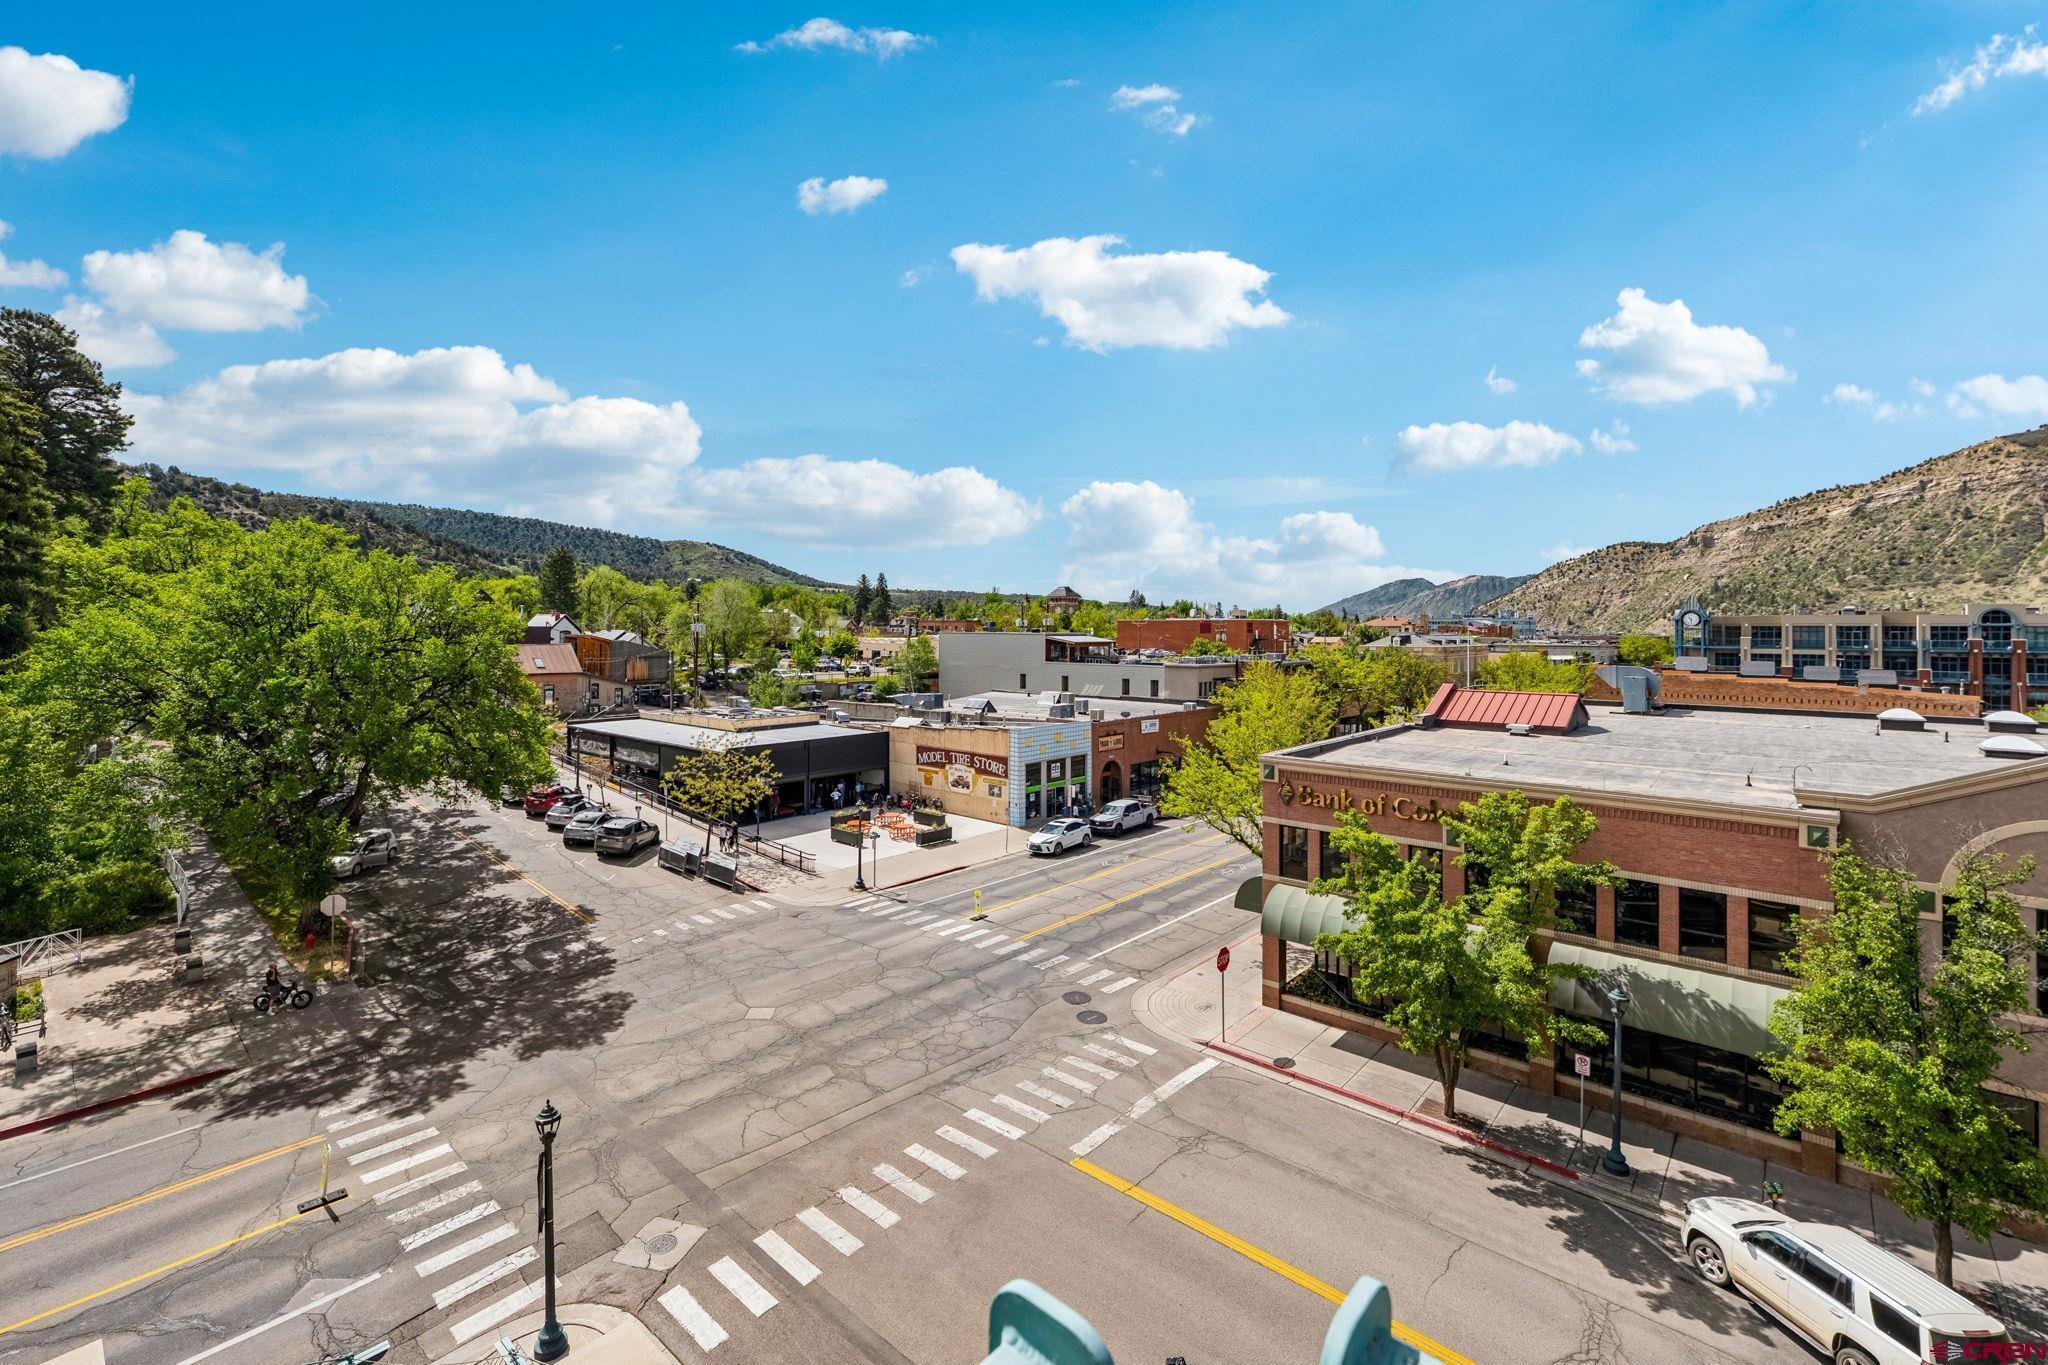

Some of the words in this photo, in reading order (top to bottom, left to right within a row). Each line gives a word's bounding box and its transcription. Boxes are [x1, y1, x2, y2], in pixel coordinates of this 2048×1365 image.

[918, 752, 949, 764] MODEL
[950, 752, 971, 766] TIRE
[973, 756, 1006, 776] STORE
[1299, 785, 1353, 810] Bank
[1361, 793, 1387, 816] of
[1217, 953, 1229, 967] STOP
